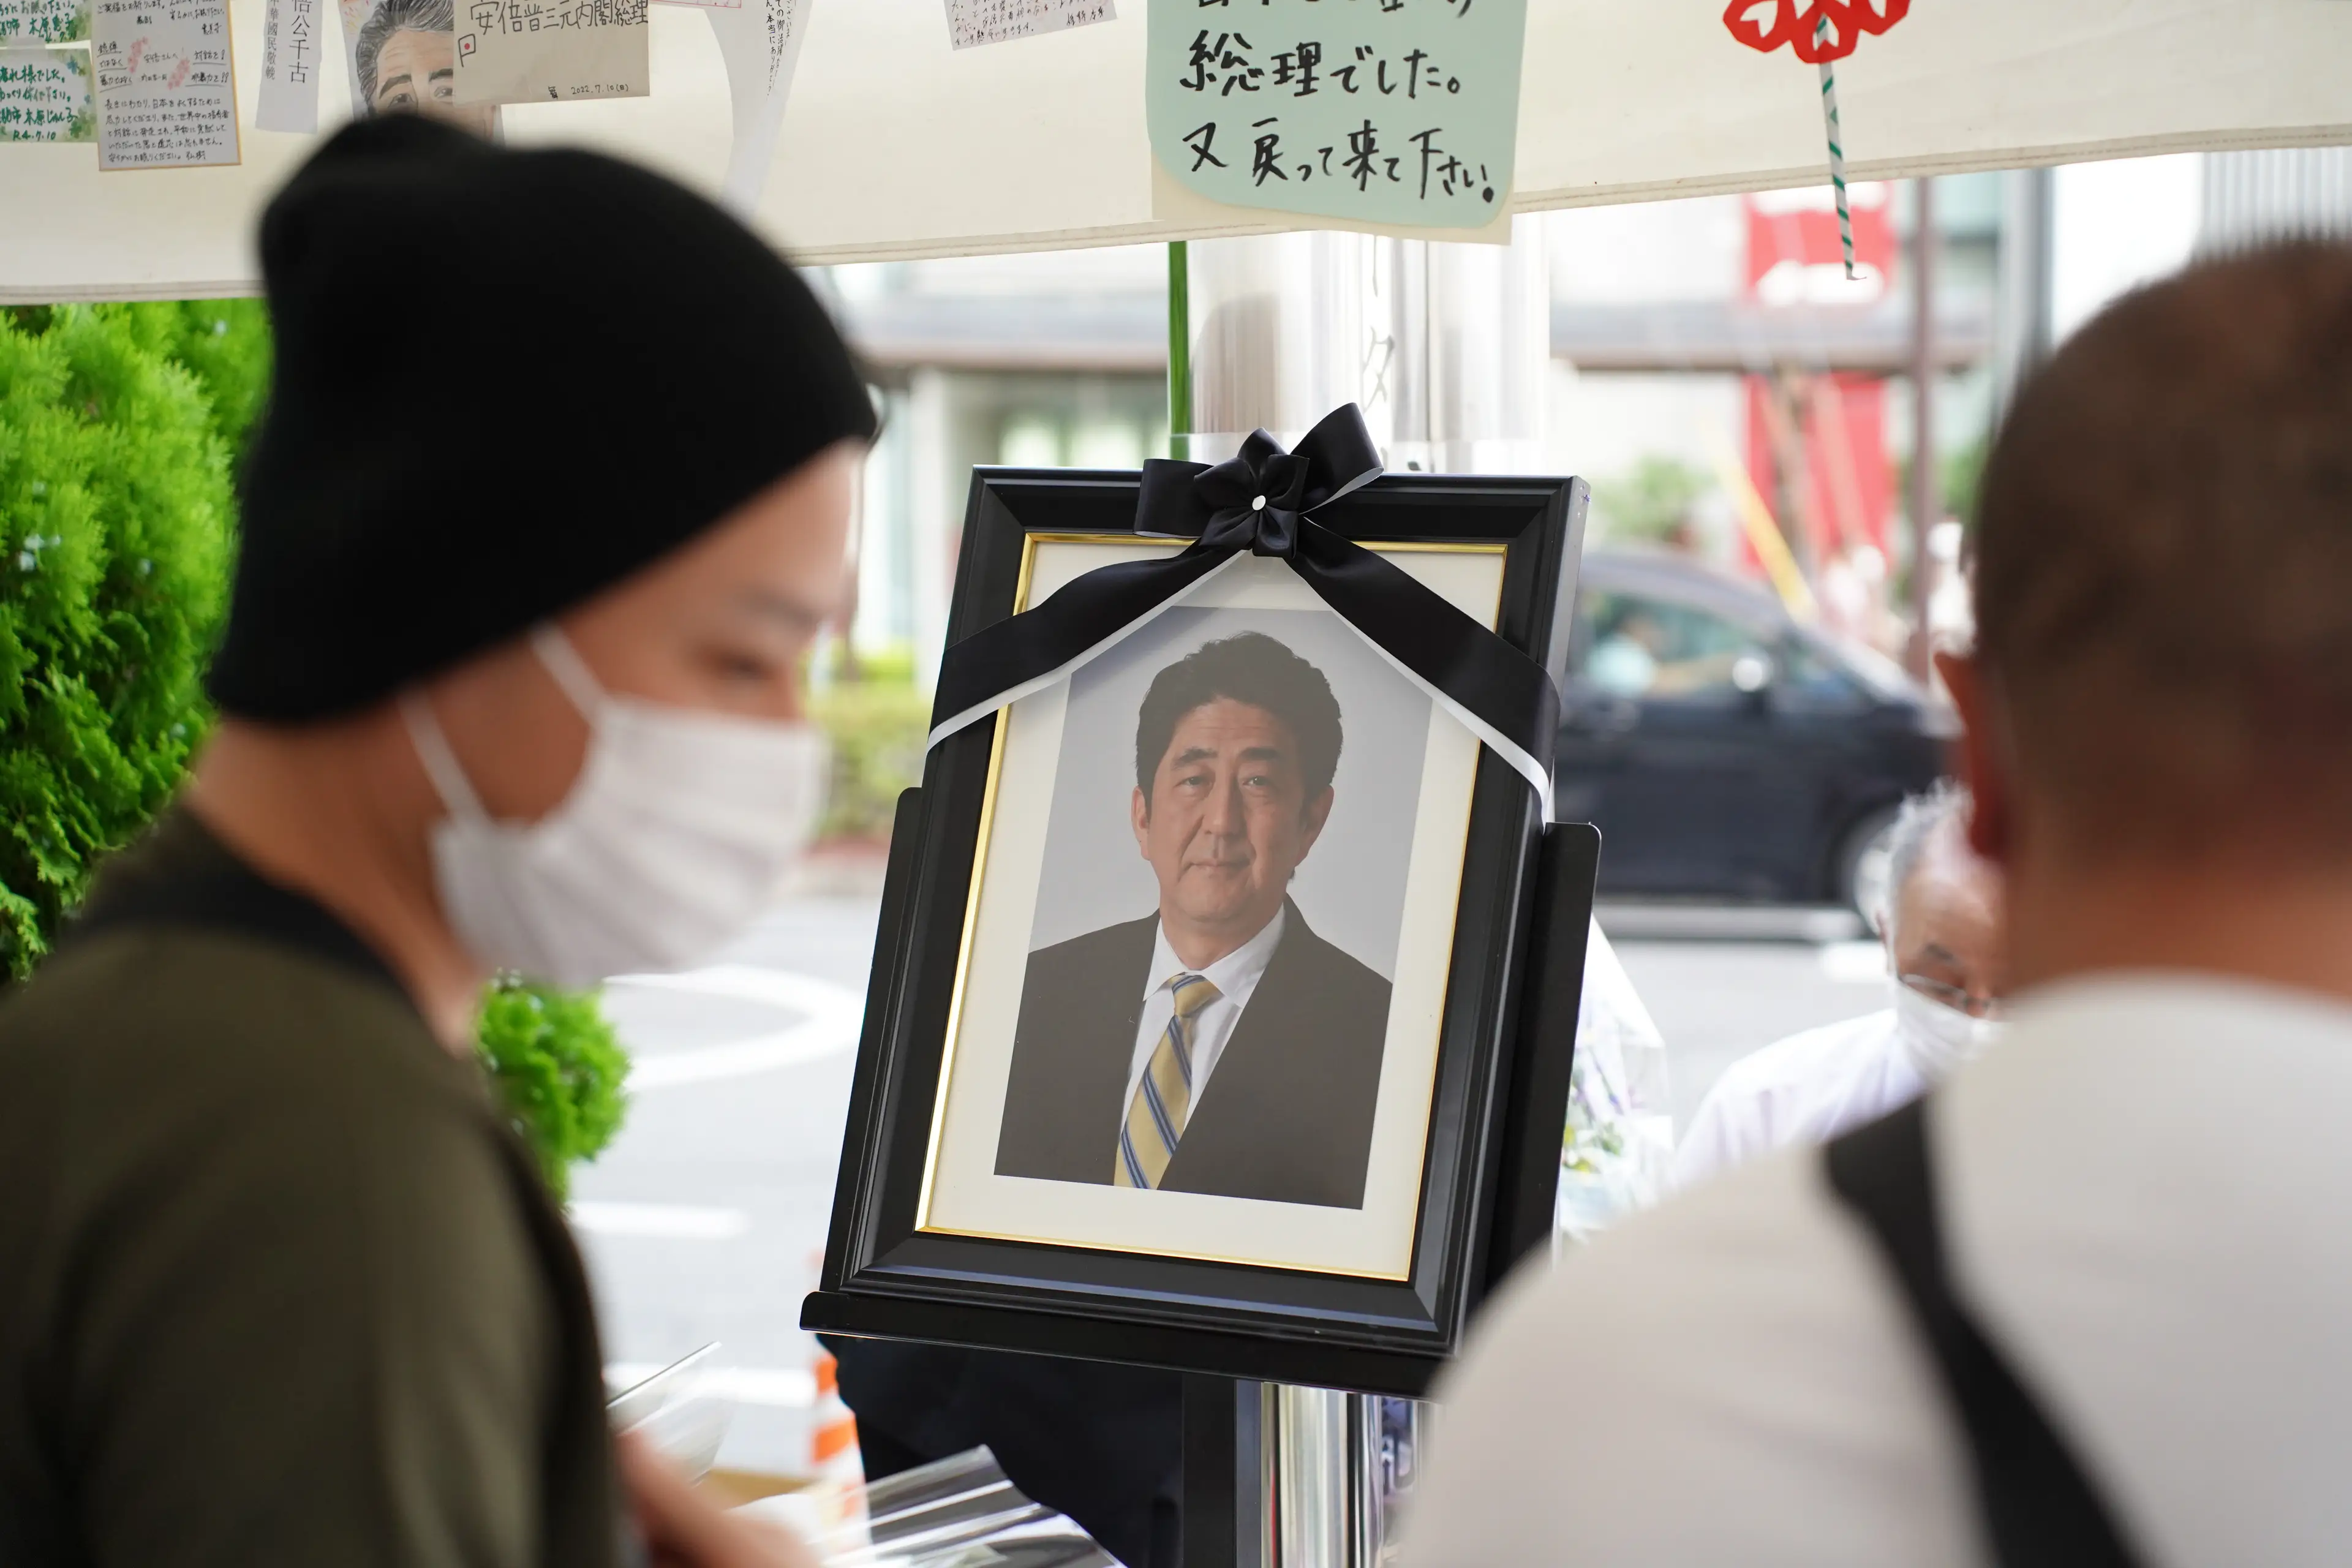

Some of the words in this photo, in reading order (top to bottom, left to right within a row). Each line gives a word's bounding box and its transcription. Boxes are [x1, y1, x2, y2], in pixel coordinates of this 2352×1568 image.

[1180, 29, 1461, 100] 総理でした。
